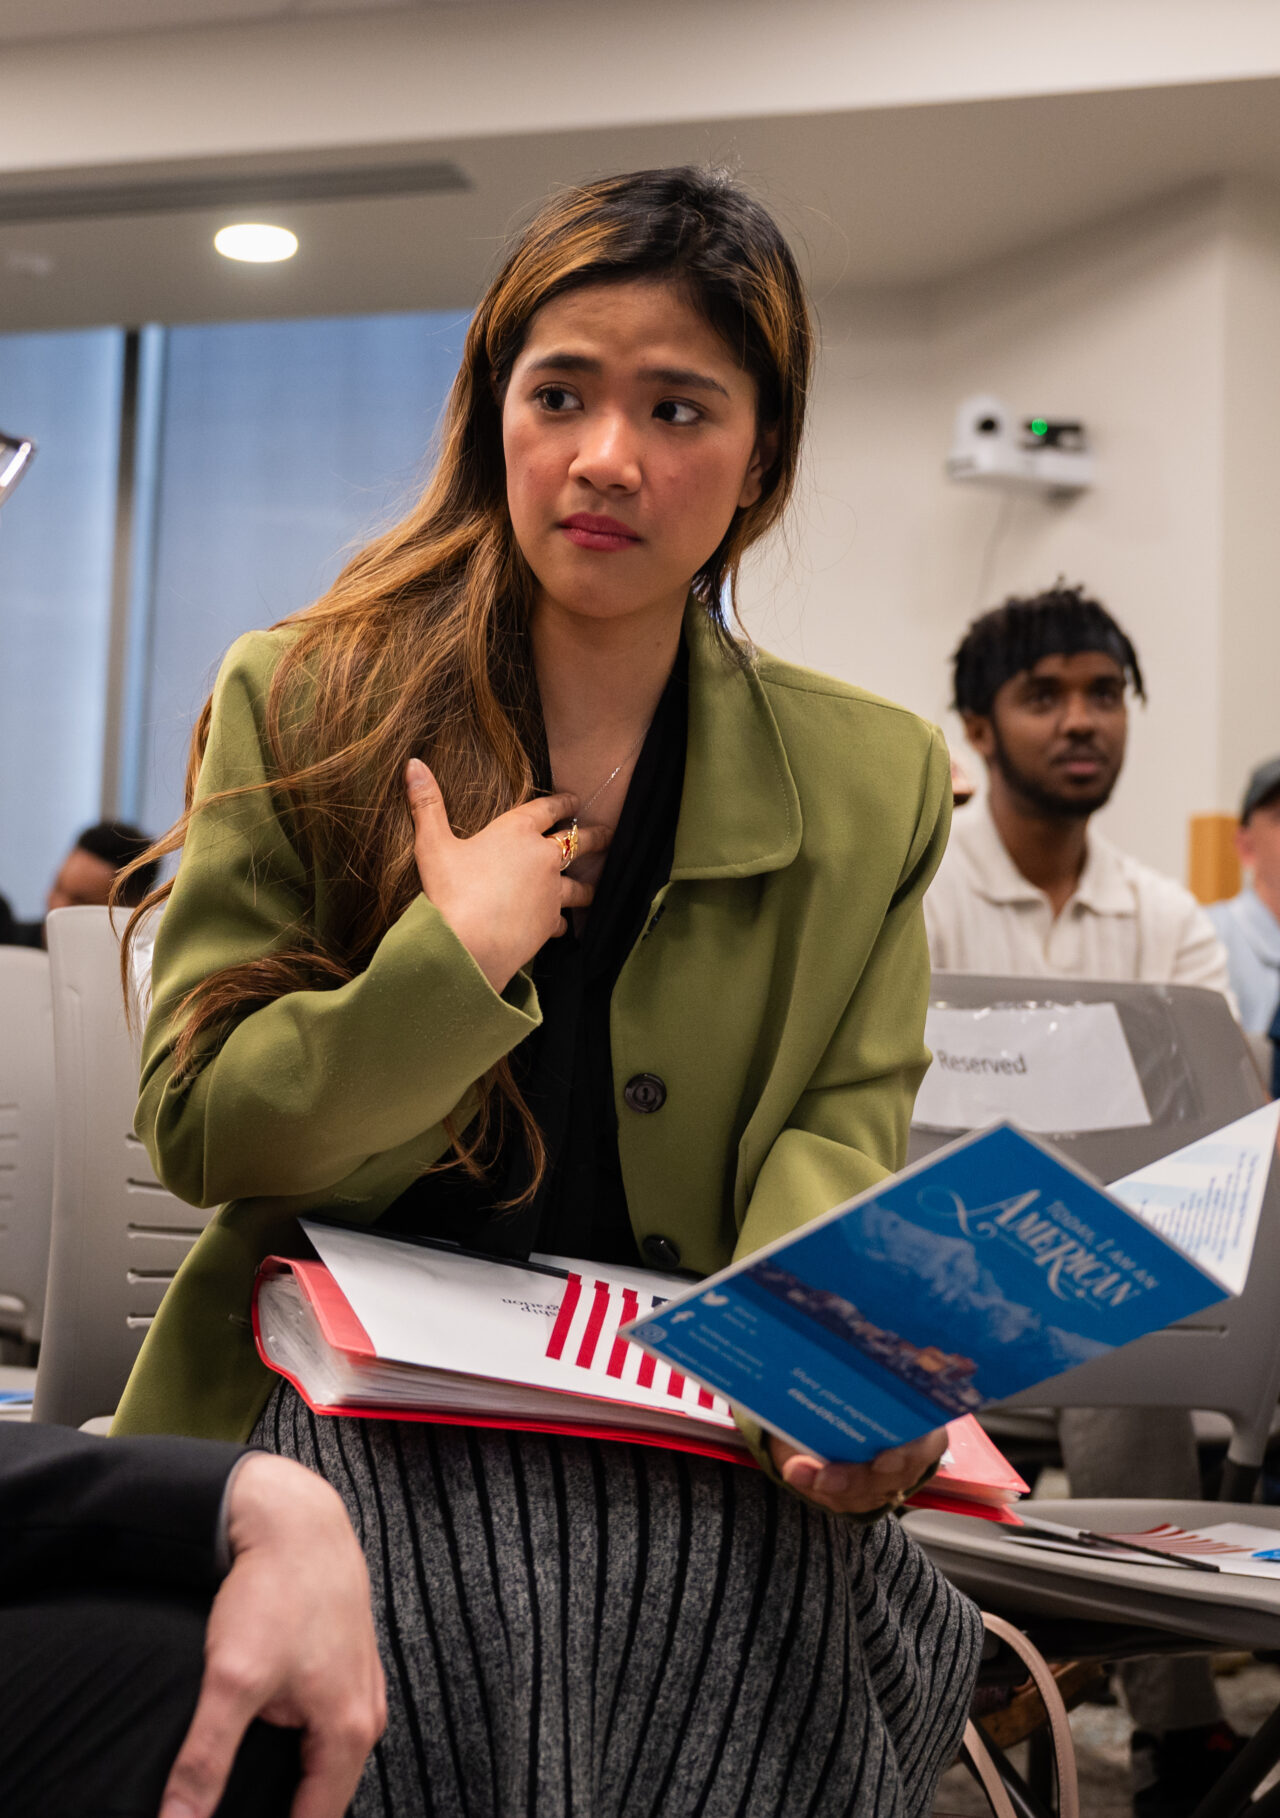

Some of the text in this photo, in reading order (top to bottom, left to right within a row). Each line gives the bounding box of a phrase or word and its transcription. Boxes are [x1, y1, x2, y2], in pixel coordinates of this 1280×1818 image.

[936, 1049, 1027, 1075] Reserved
[917, 1184, 1142, 1306] AMERICAN
[502, 1298, 559, 1310] gration
[520, 1306, 557, 1316] ship
